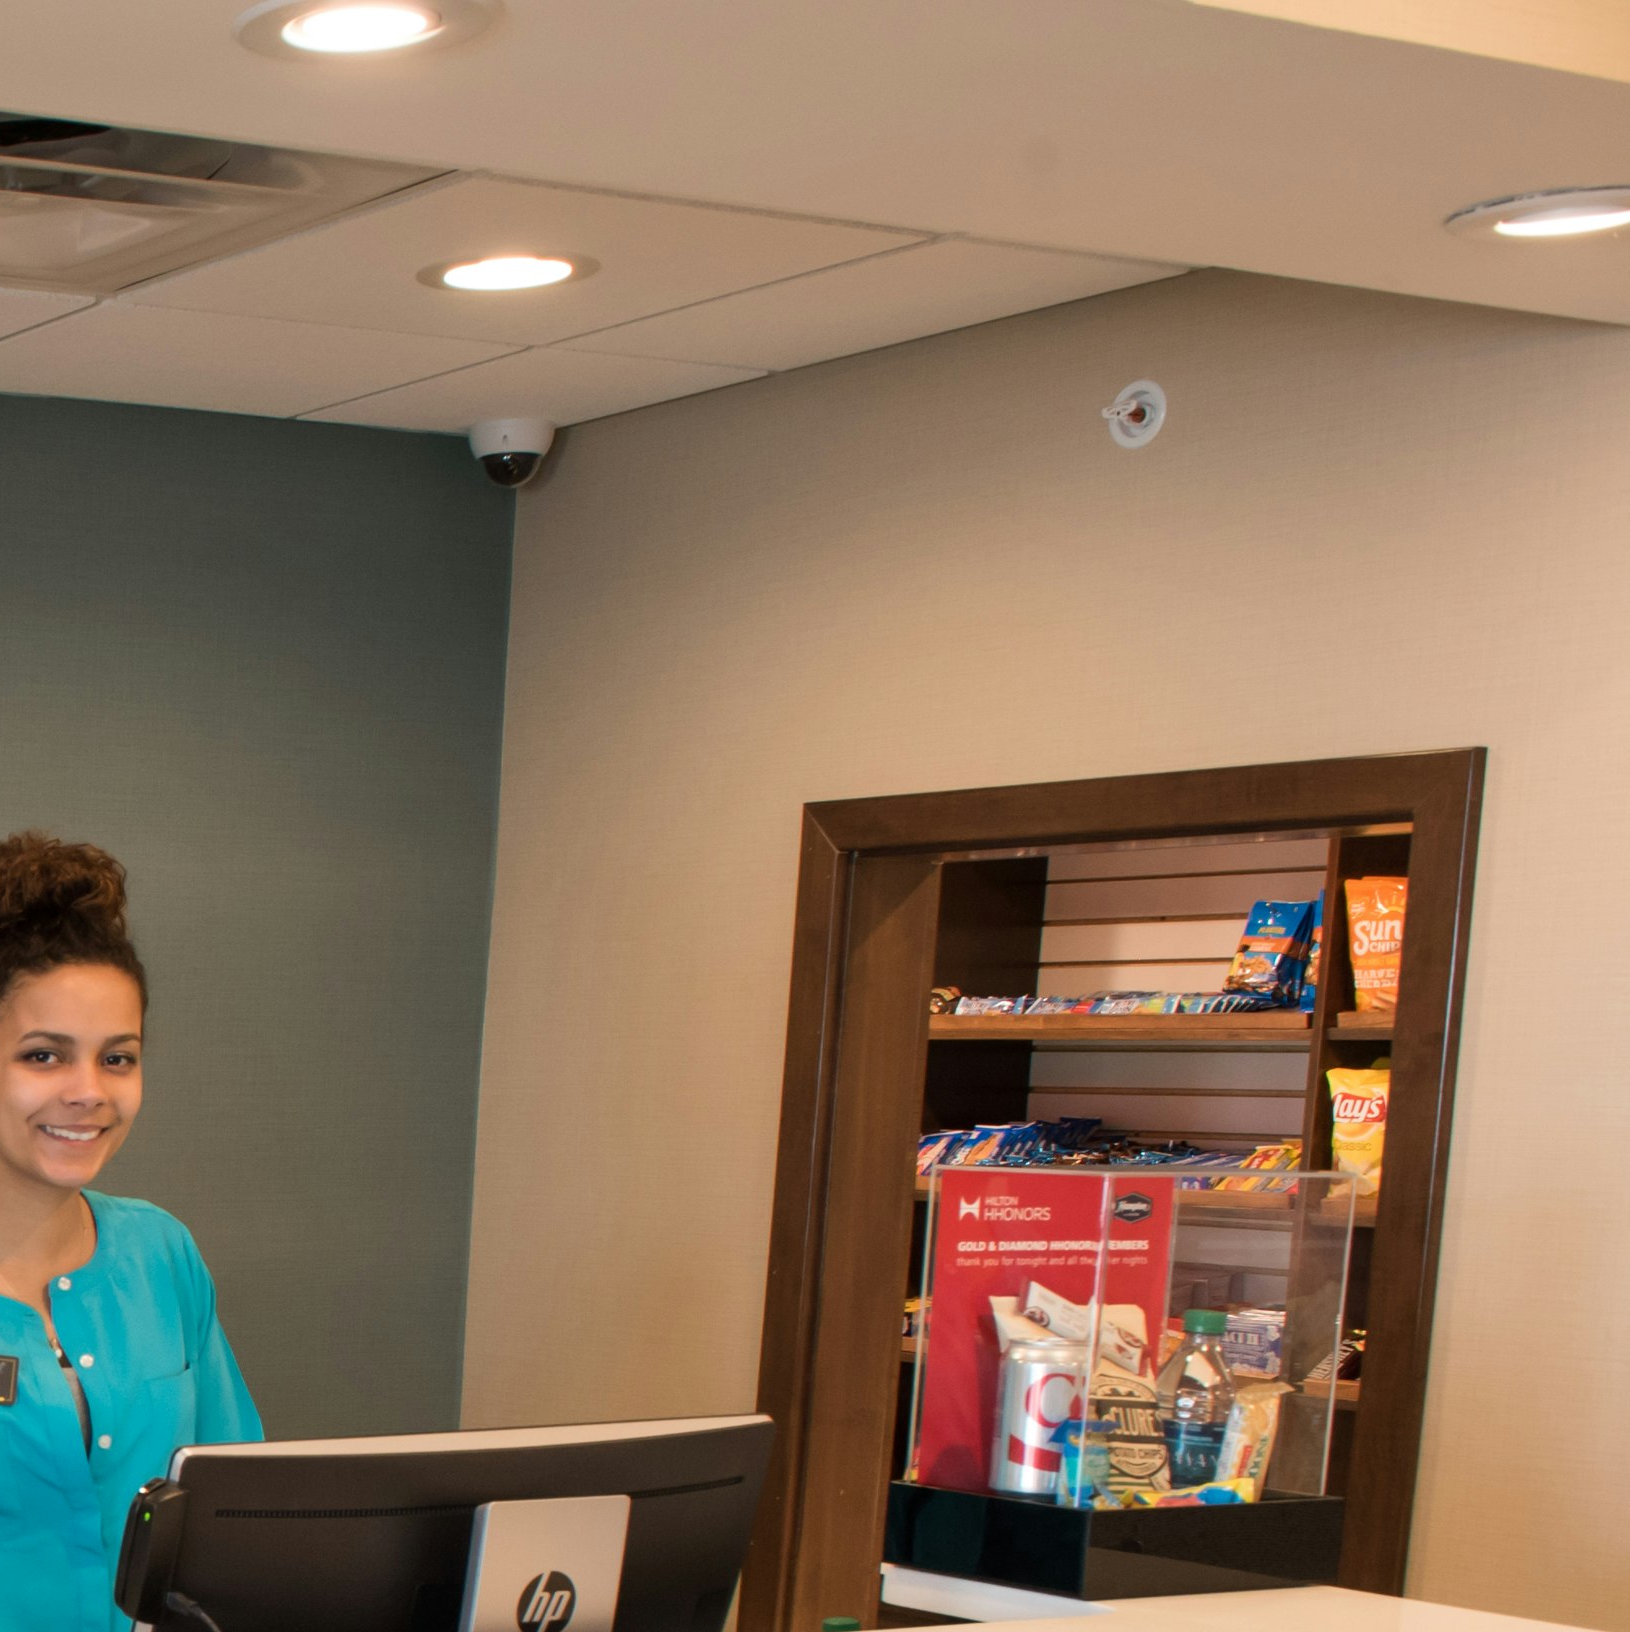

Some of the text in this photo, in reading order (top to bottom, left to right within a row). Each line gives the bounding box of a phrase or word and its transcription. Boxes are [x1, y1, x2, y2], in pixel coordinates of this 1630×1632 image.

[1353, 919, 1402, 956] Sun
[1369, 941, 1401, 953] CHIP
[1354, 968, 1398, 979] HARVE
[985, 1196, 1018, 1206] HILTON
[984, 1207, 1051, 1221] HHONORS
[957, 1241, 987, 1251] GOLD
[988, 1241, 997, 1251] &
[998, 1240, 1048, 1251] DIAMOND
[1107, 1240, 1149, 1250] EMBERS
